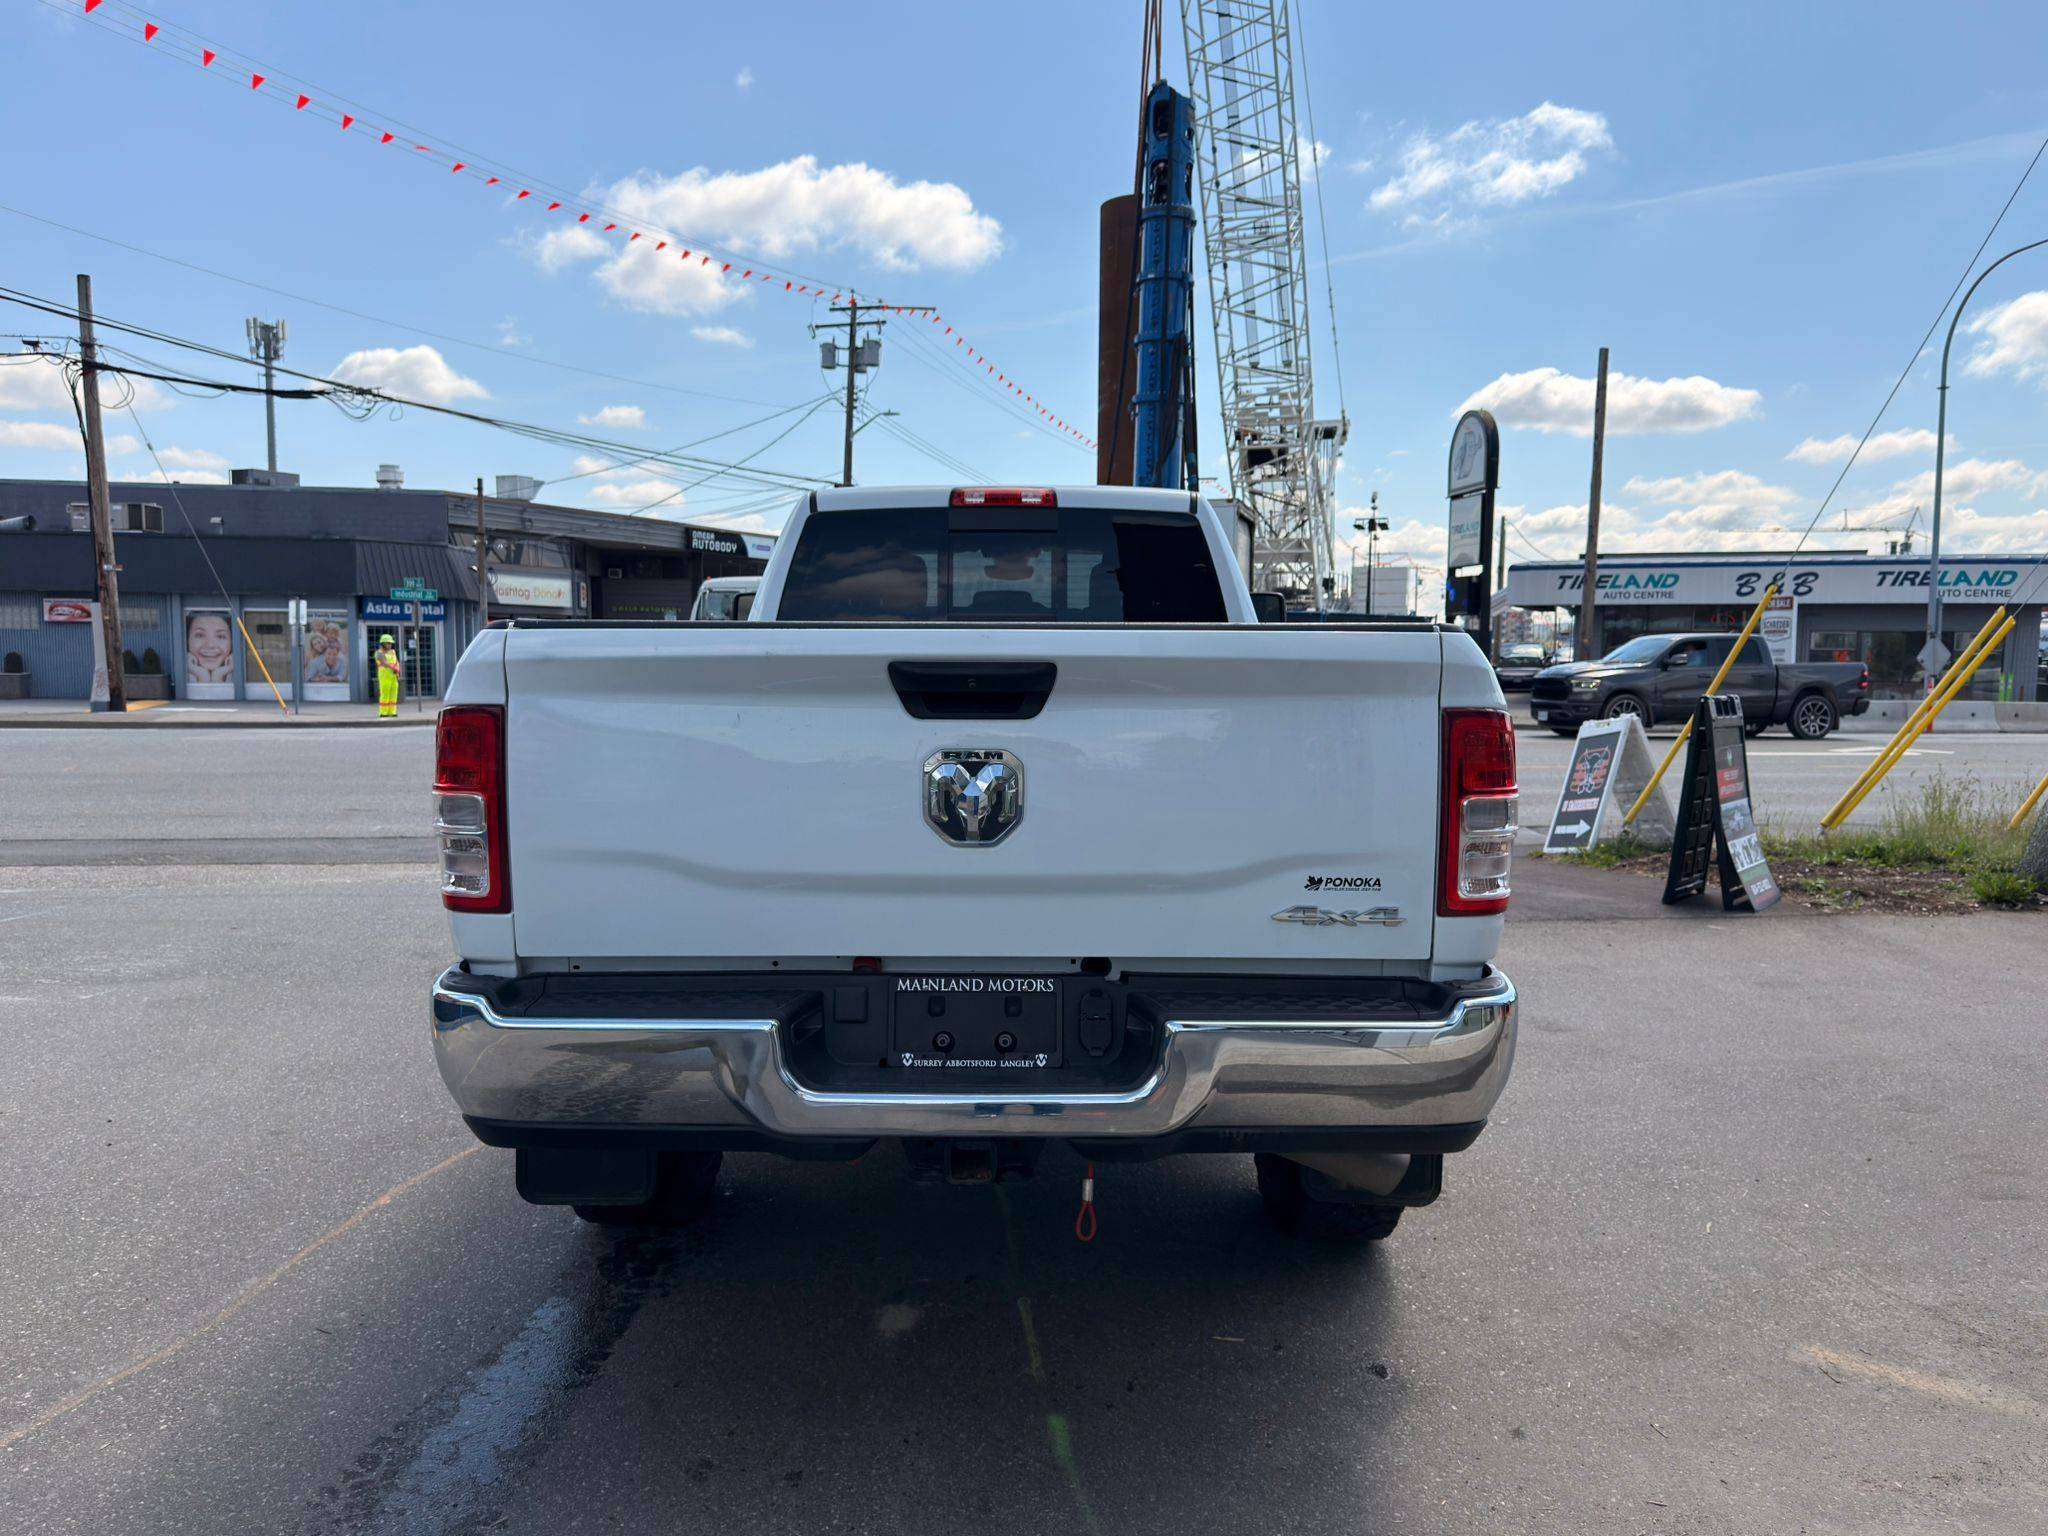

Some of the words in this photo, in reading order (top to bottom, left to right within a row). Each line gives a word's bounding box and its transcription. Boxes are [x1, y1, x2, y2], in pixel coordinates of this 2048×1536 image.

[691, 539, 738, 554] AUTOBODY
[1557, 573, 1680, 590] TIELAND
[1736, 572, 1762, 597] B
[1793, 572, 1819, 597] B
[1603, 591, 1631, 600] AUTO
[1633, 591, 1674, 600] CENTRE
[1938, 589, 1960, 598] UTO
[1964, 589, 2012, 598] CENTRE
[366, 602, 401, 615] Astra
[404, 603, 445, 616] Dntal
[941, 751, 1004, 760] RAM
[1324, 877, 1381, 888] PONOKA
[897, 978, 984, 992] MAINLAND
[987, 978, 1054, 992] MOTORS
[913, 1059, 943, 1068] SURREY
[945, 1059, 997, 1068] ABBOTSFORD
[1000, 1059, 1035, 1068] LANGLEY
